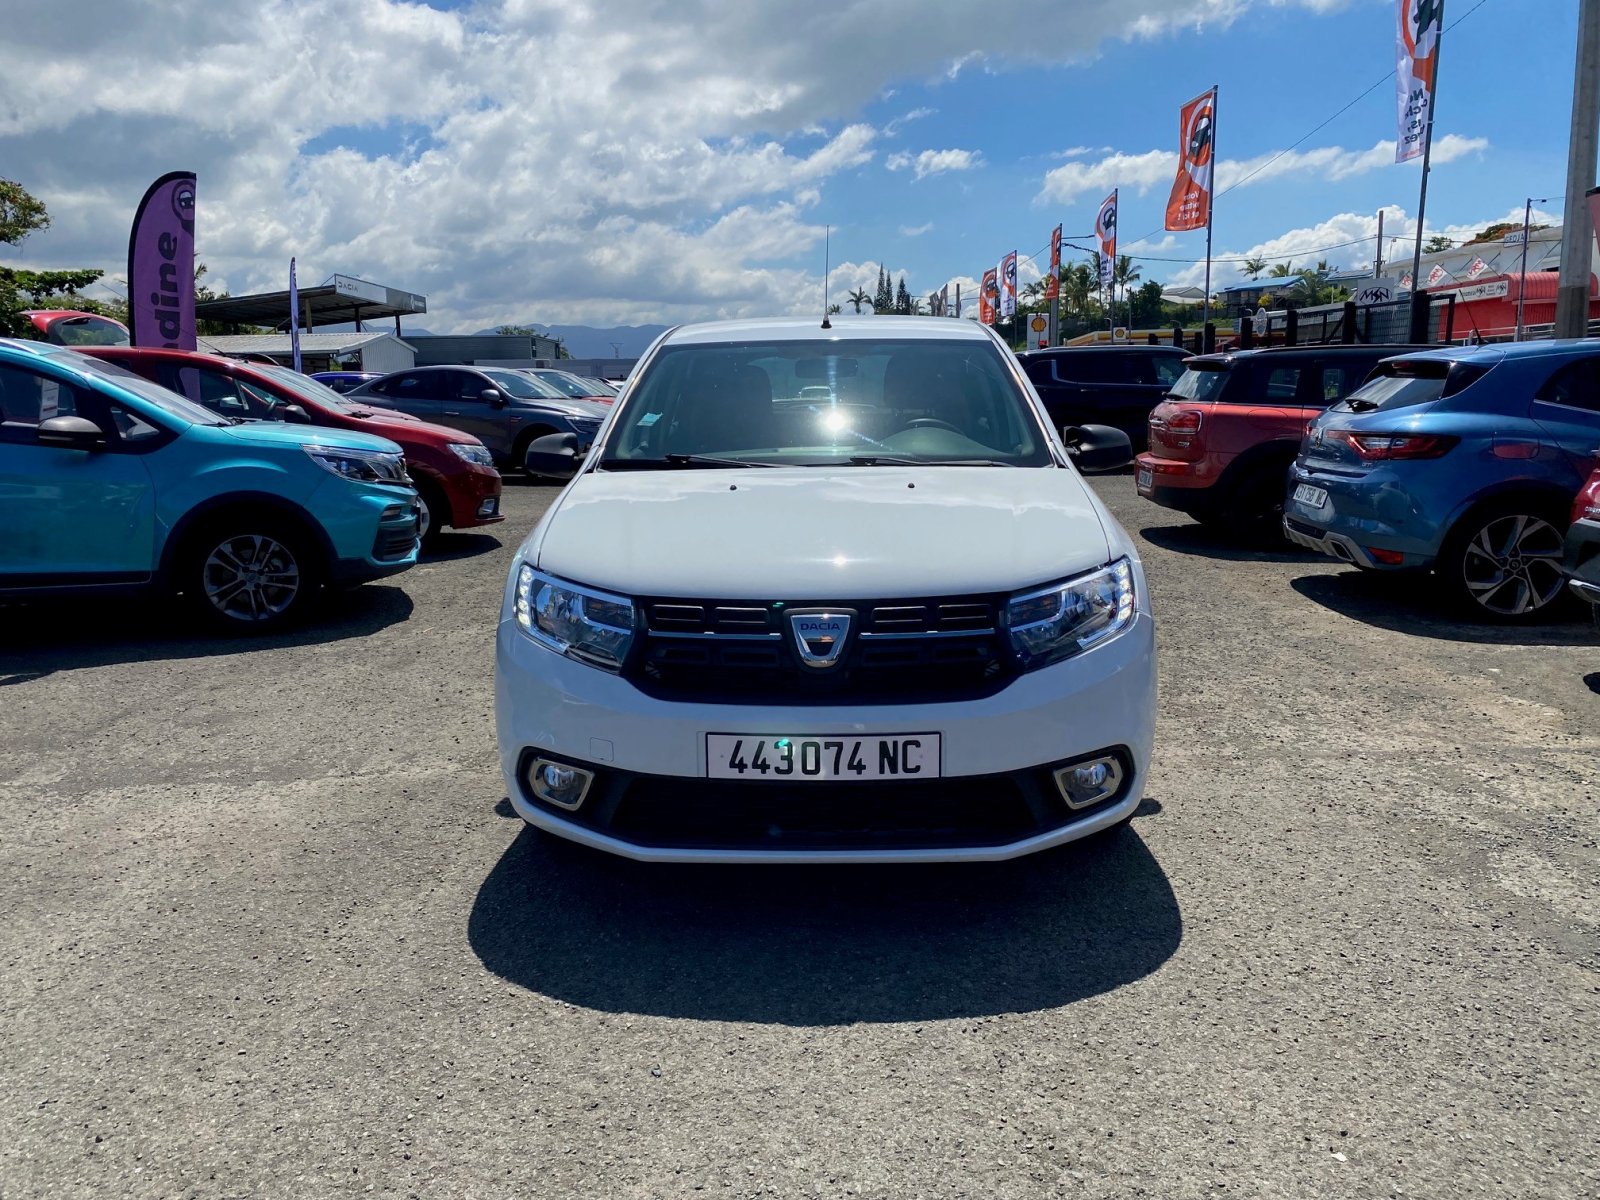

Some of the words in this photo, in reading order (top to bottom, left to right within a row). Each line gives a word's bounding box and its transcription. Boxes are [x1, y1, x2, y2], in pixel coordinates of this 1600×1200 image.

[151, 231, 181, 350] dine
[338, 281, 359, 292] DACIA
[800, 623, 840, 631] DACIA
[729, 740, 867, 775] 443074
[879, 740, 921, 775] NC
